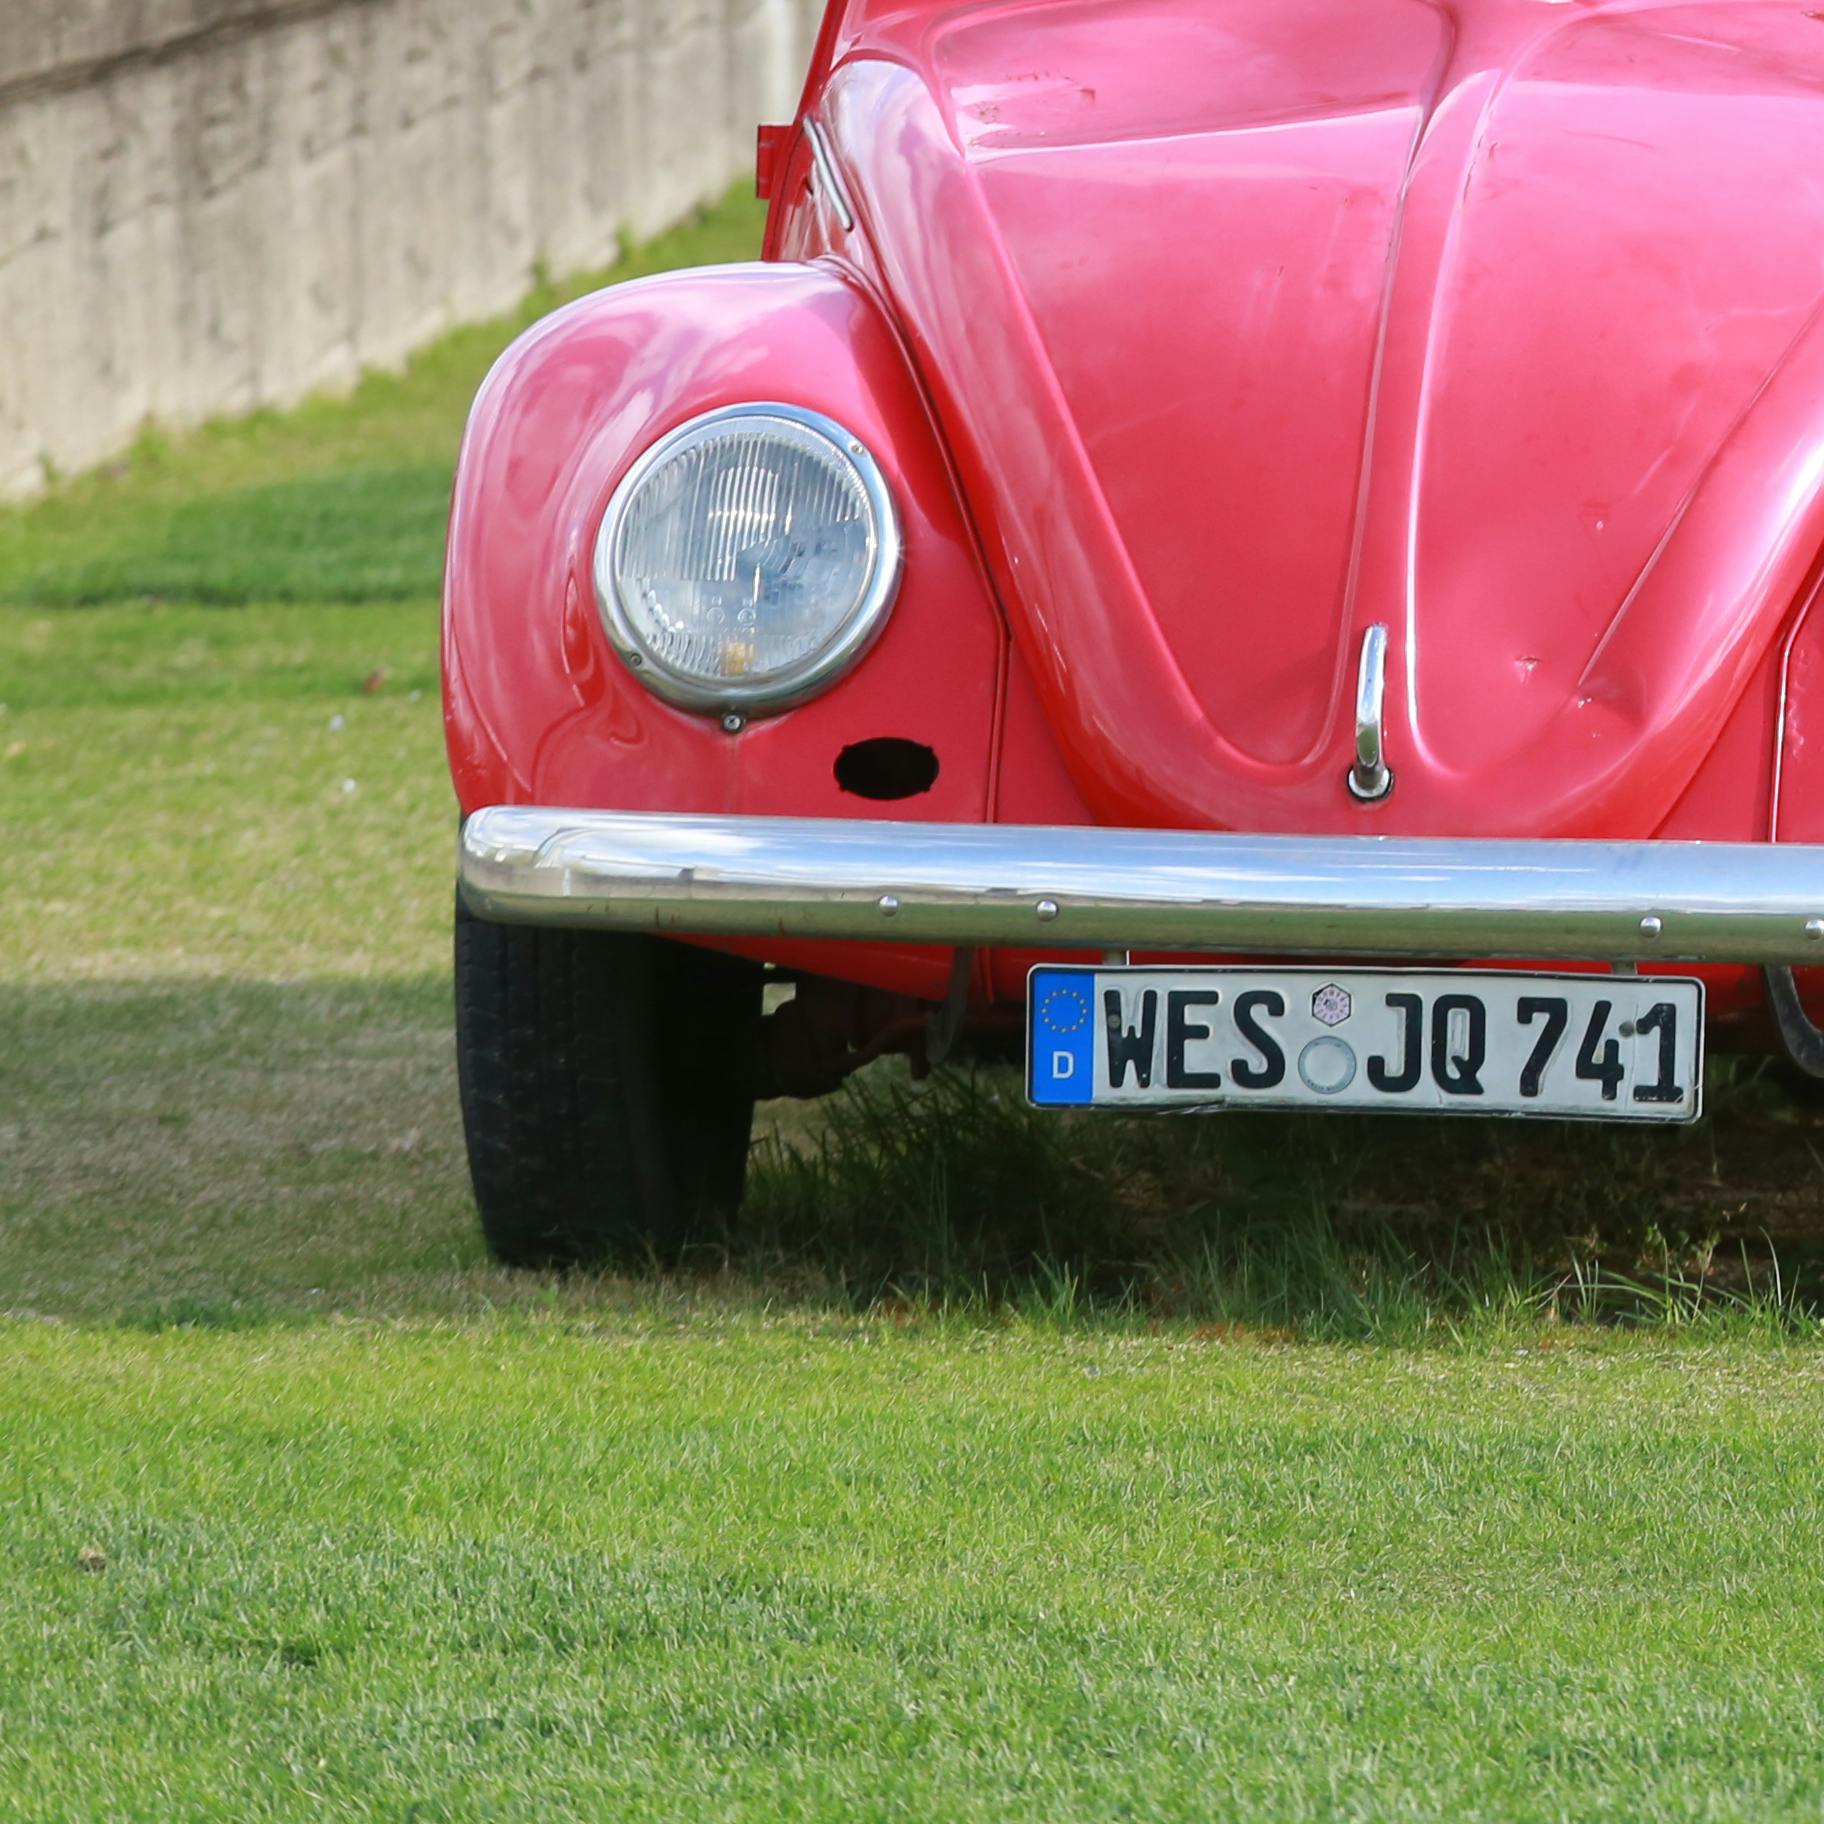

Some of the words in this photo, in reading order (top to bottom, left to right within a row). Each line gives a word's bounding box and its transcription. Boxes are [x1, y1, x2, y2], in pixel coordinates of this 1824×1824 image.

[1053, 1050, 1074, 1079] D
[1103, 989, 1286, 1090] WES
[1367, 992, 1486, 1095] JQ
[1516, 996, 1685, 1103] 741
